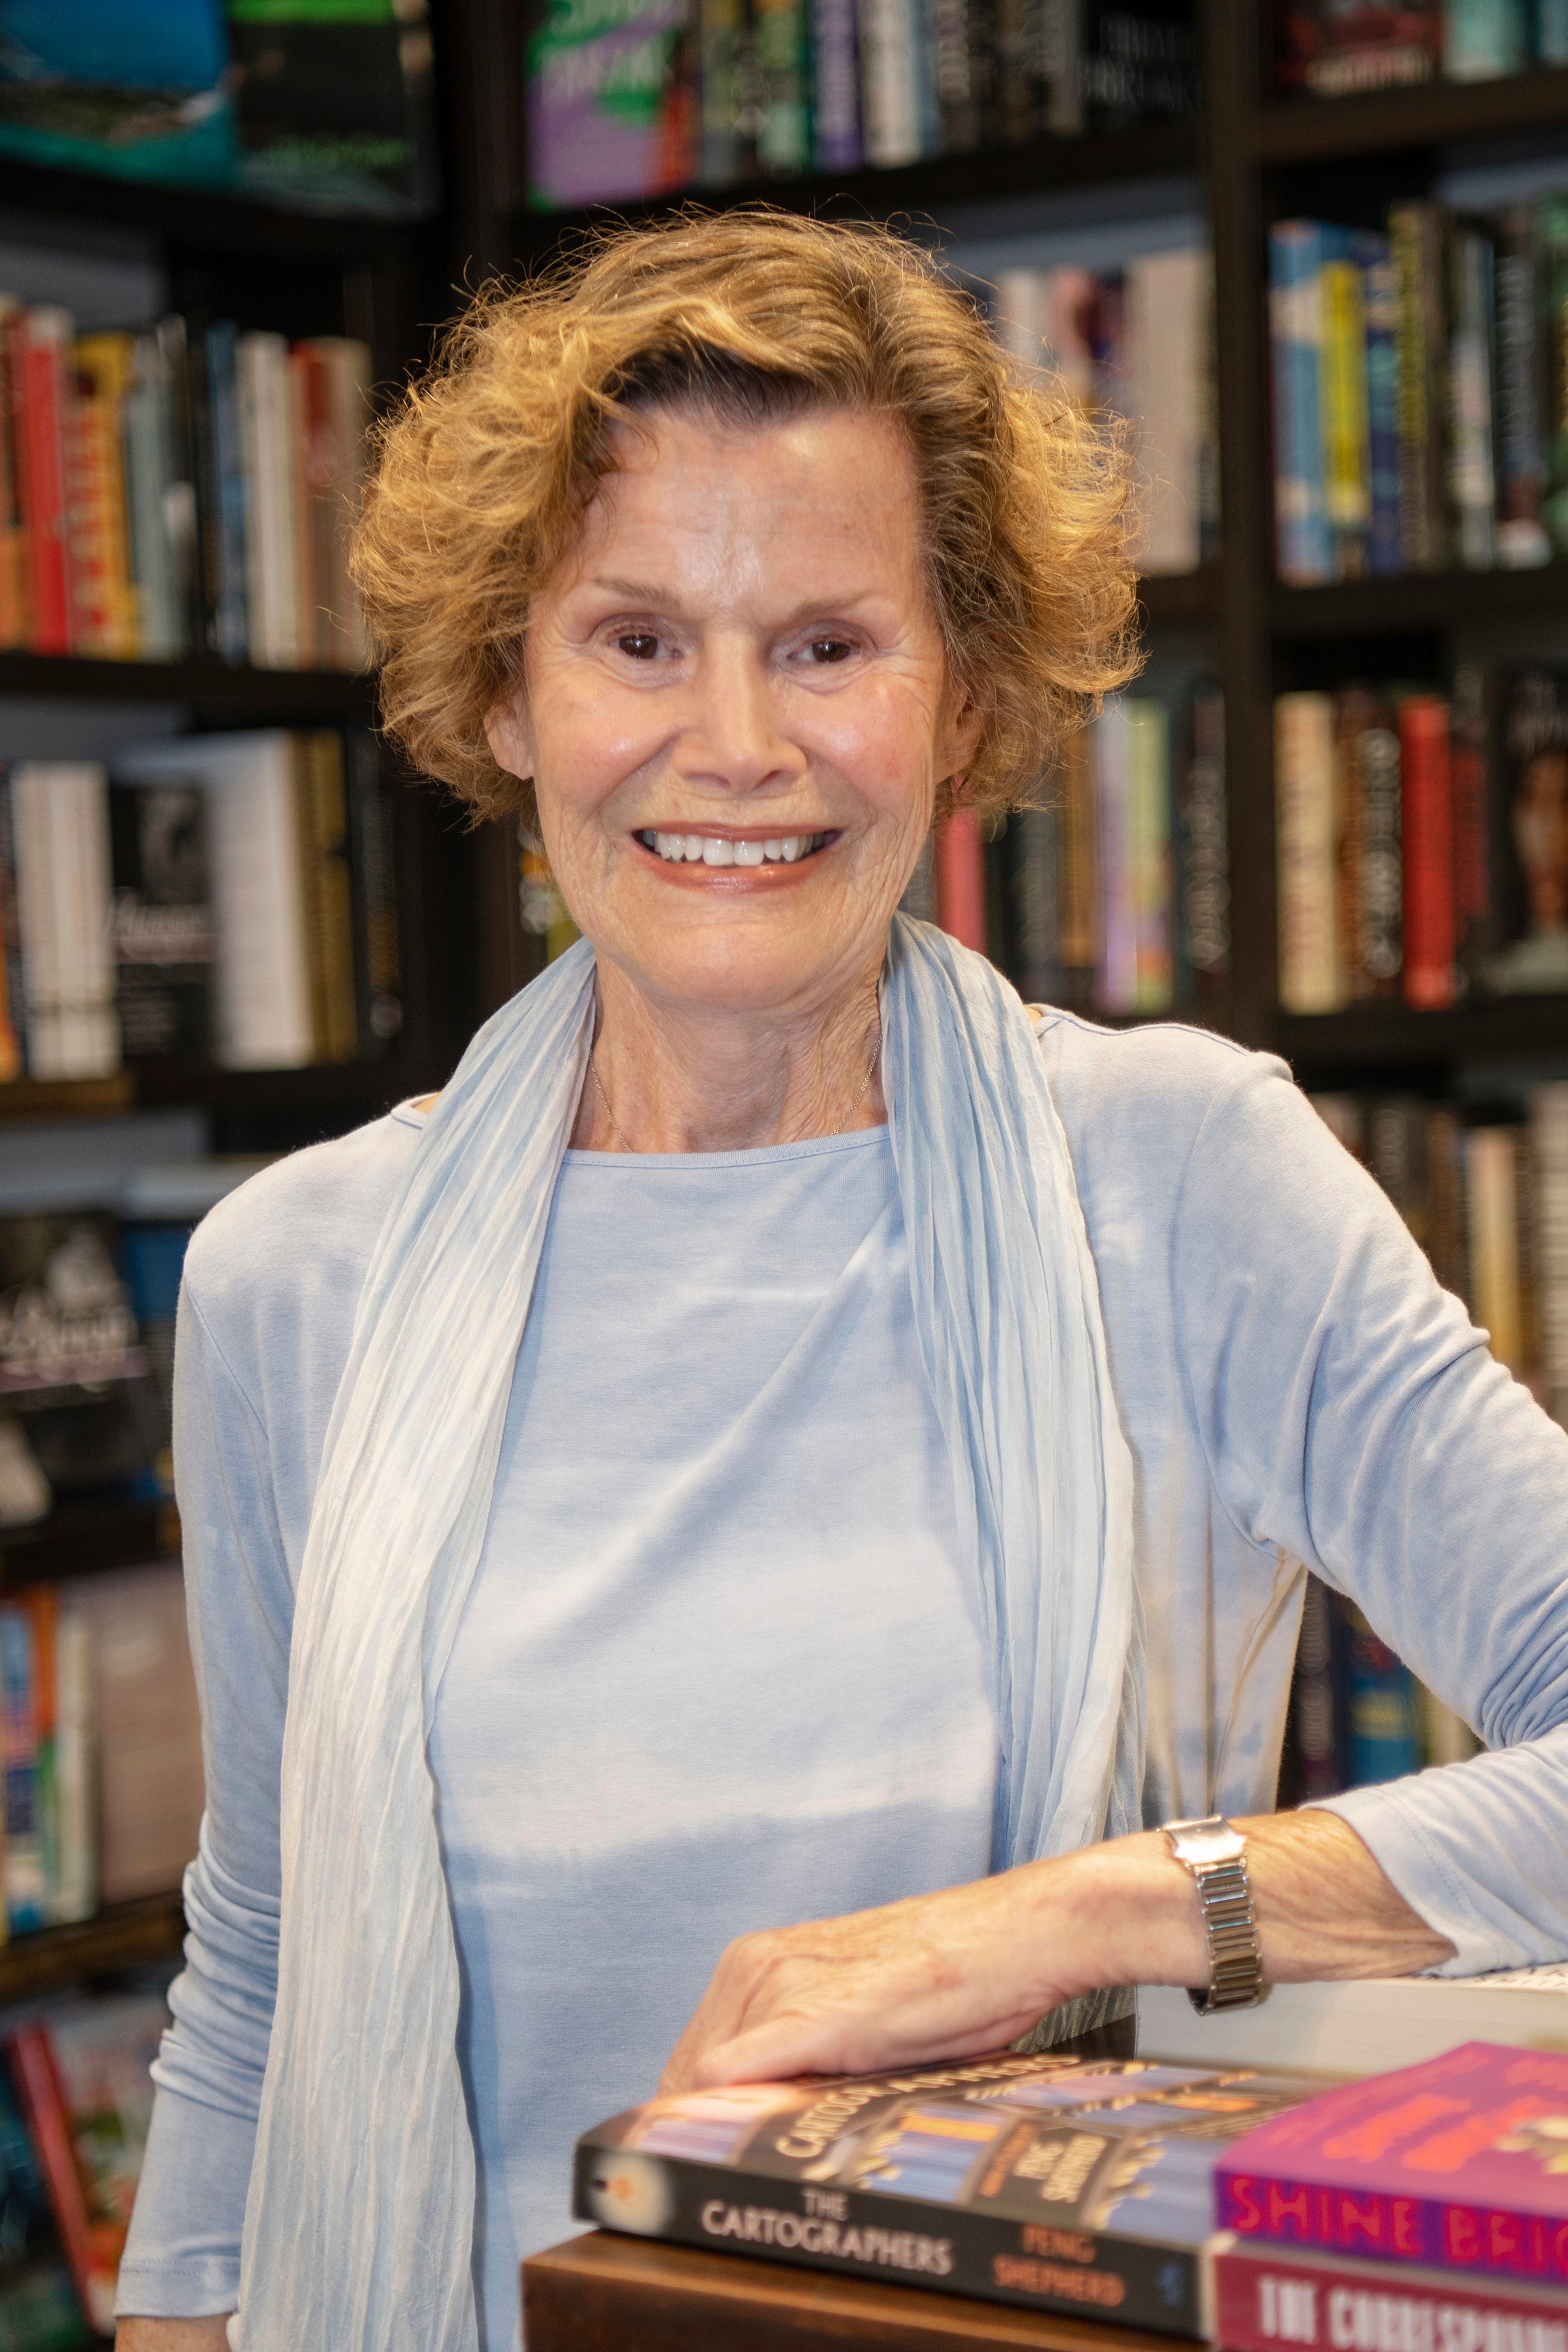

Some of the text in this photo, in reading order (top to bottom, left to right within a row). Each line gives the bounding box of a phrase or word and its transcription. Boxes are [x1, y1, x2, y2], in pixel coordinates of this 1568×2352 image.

[700, 2198, 954, 2277] CARTOGRAPHERS
[803, 2187, 848, 2221] THE
[1226, 2171, 1426, 2258] SHINE
